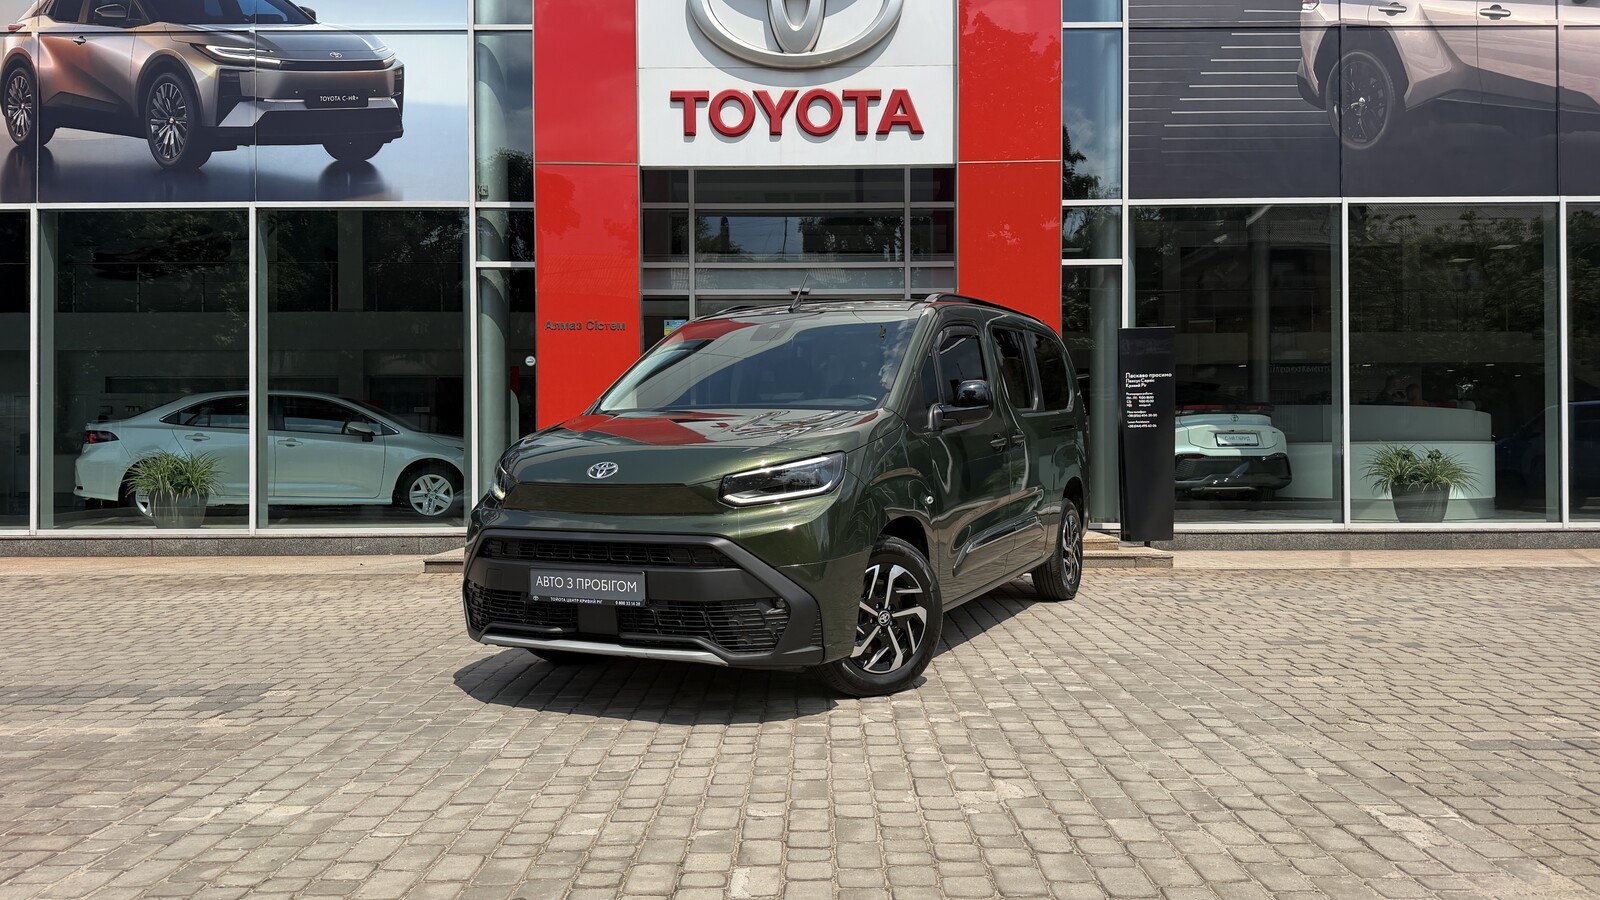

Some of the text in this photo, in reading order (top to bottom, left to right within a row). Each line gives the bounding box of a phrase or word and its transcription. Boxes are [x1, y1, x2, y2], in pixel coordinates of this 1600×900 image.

[670, 88, 925, 137] TOYOTA
[544, 320, 626, 331] Алмаз Сістем
[535, 575, 564, 588] АВТО
[576, 578, 637, 593] ПРОБІГОМ
